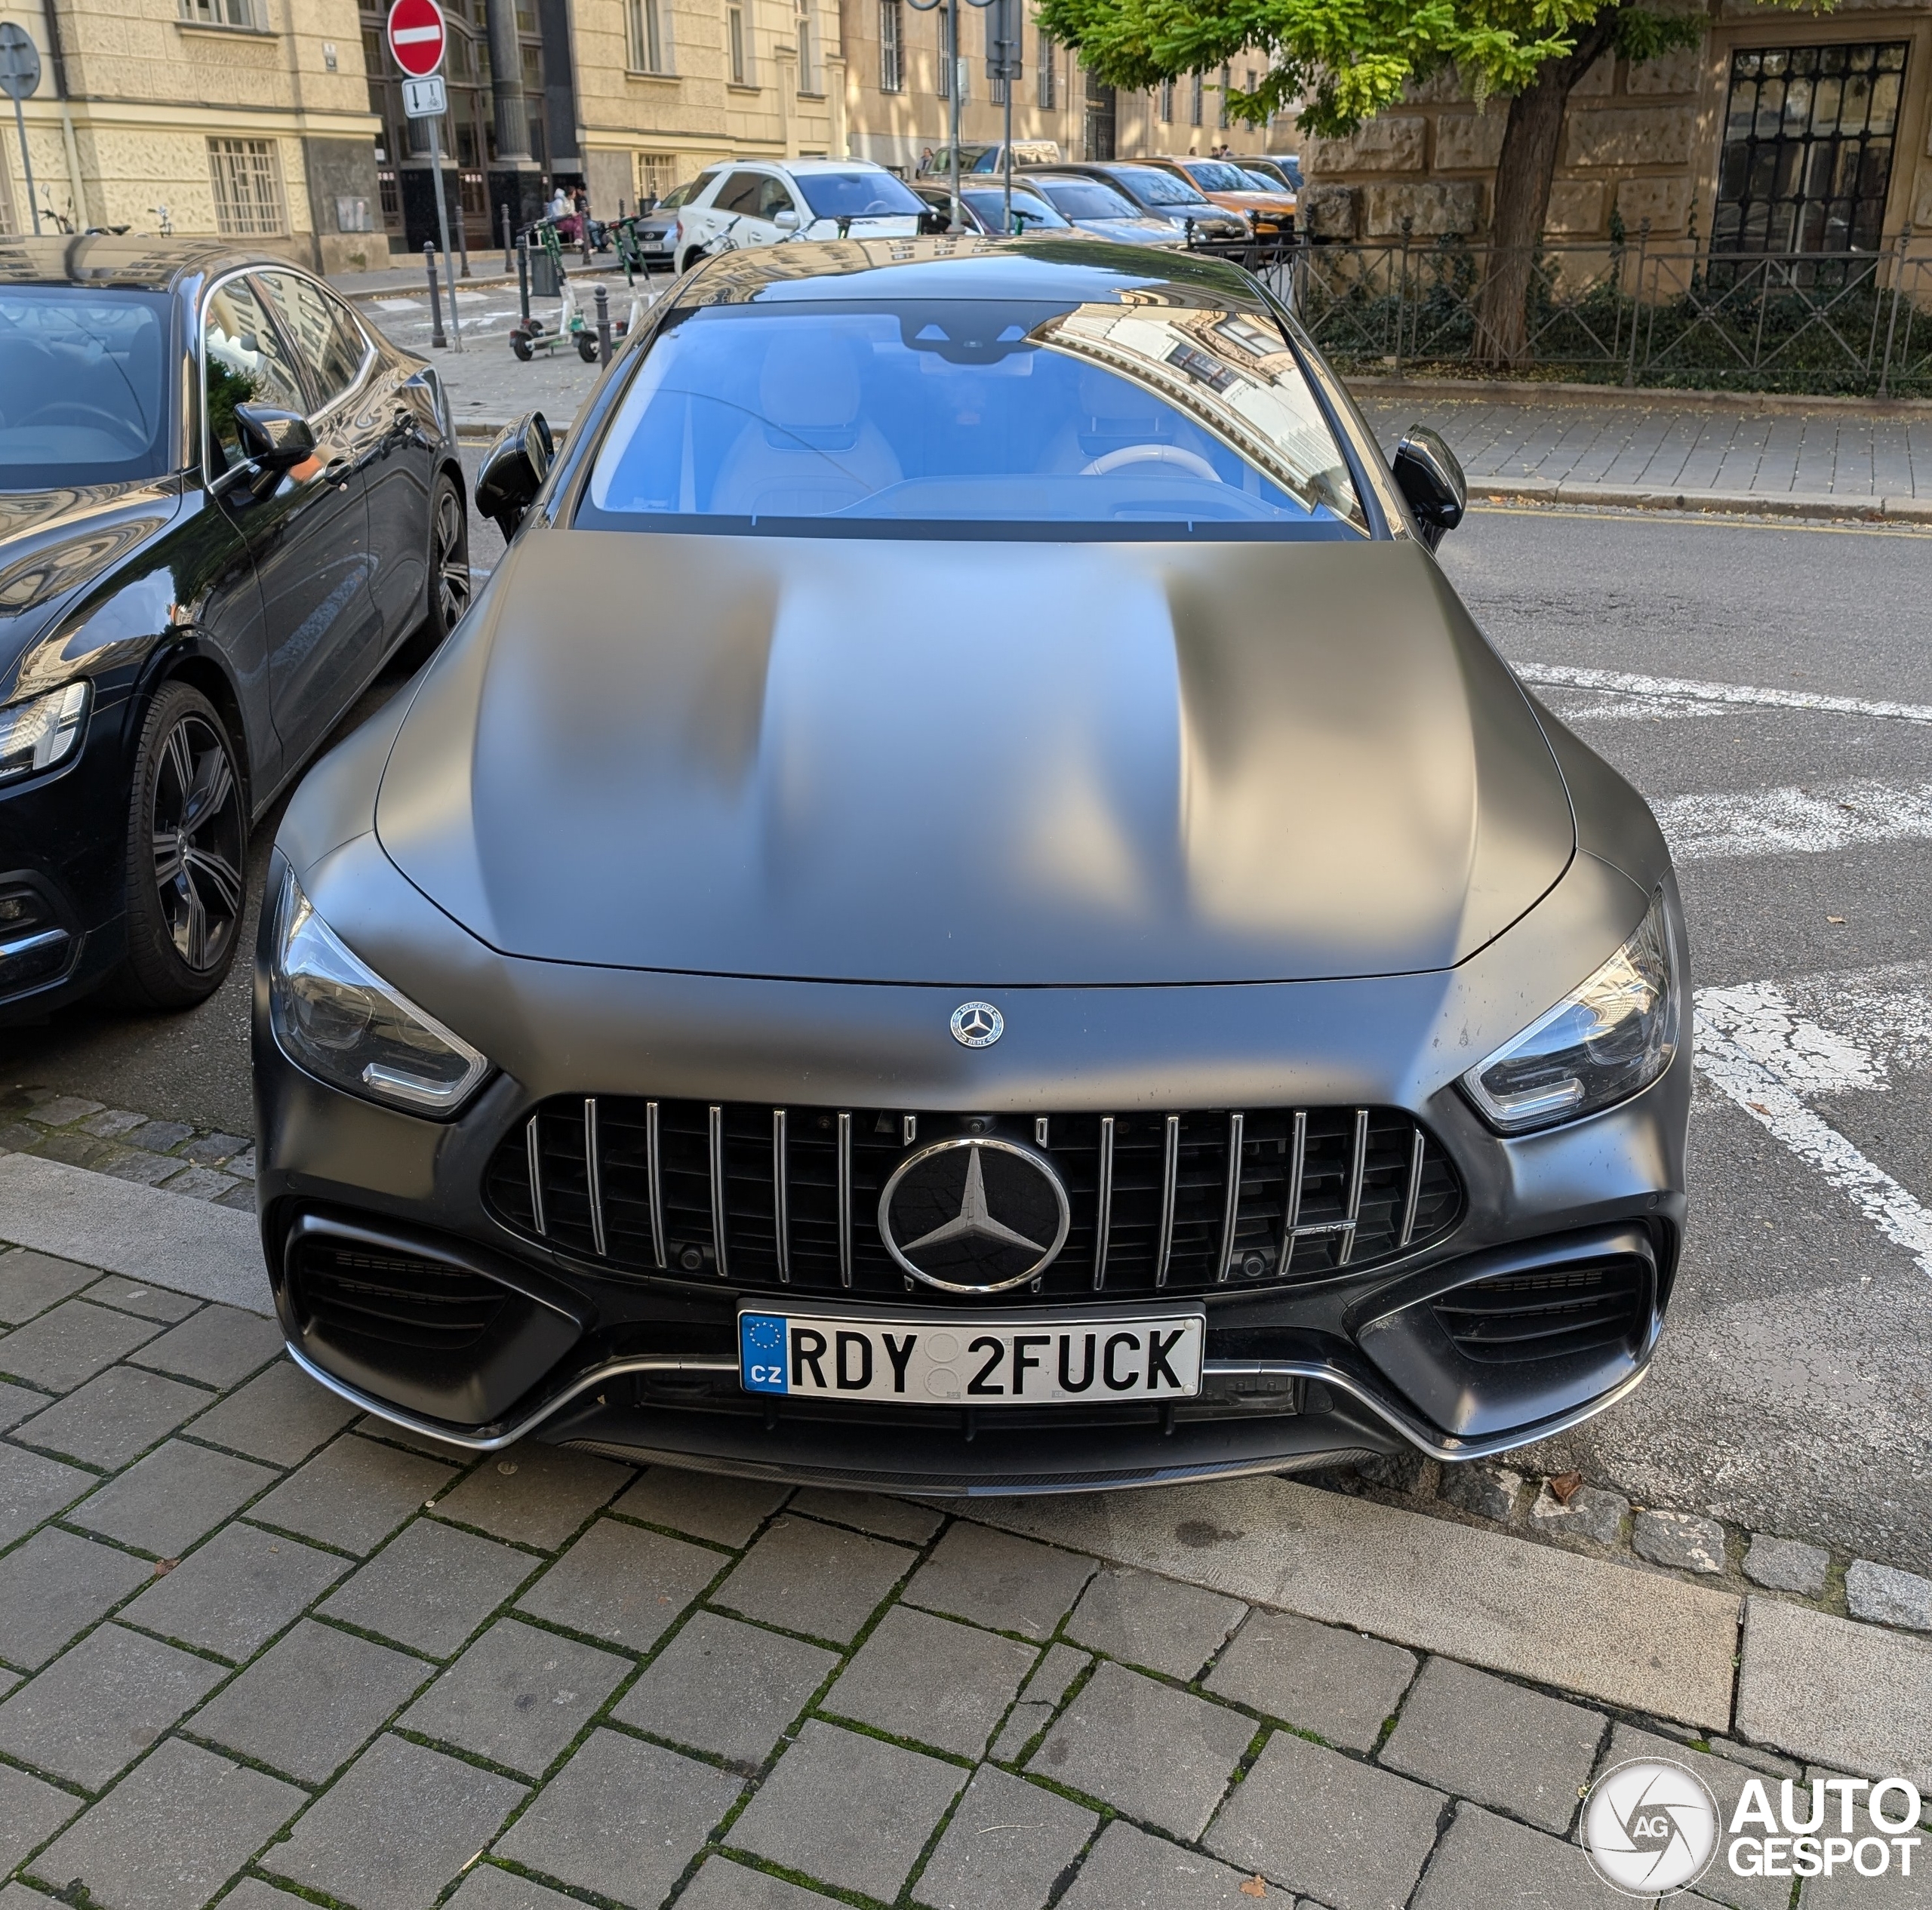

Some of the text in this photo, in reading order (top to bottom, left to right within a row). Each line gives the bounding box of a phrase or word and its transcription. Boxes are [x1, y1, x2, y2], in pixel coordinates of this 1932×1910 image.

[961, 1004, 994, 1013] MERCEDES
[791, 1327, 1186, 1395] RDY 2FUCK
[750, 1364, 782, 1384] CZ
